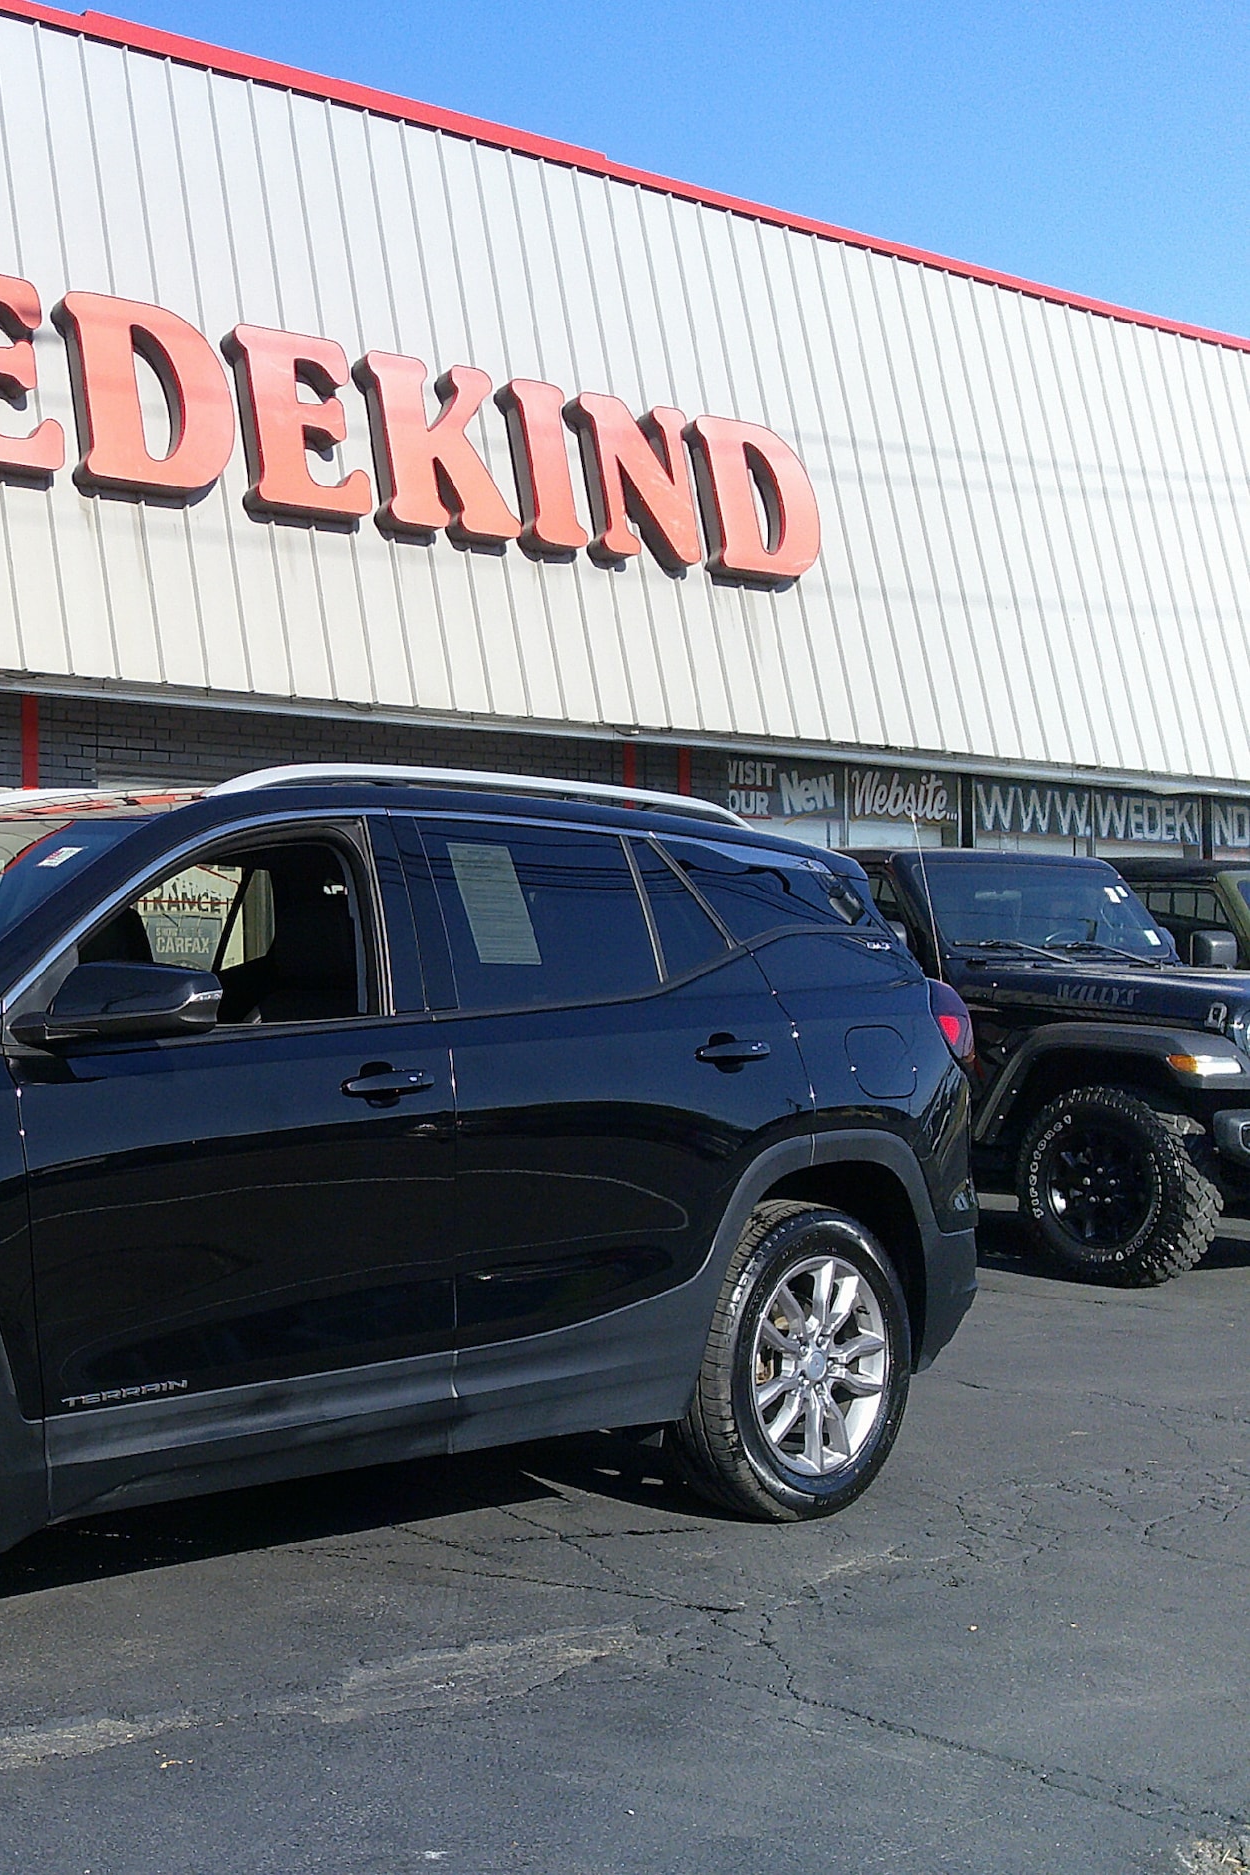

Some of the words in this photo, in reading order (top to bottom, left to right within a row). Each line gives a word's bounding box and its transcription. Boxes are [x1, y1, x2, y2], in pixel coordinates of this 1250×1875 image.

[727, 759, 777, 787] VISIT
[728, 789, 770, 816] OUR
[779, 769, 836, 816] New
[156, 936, 210, 954] CARFAX
[60, 1379, 188, 1407] TERRAIN
